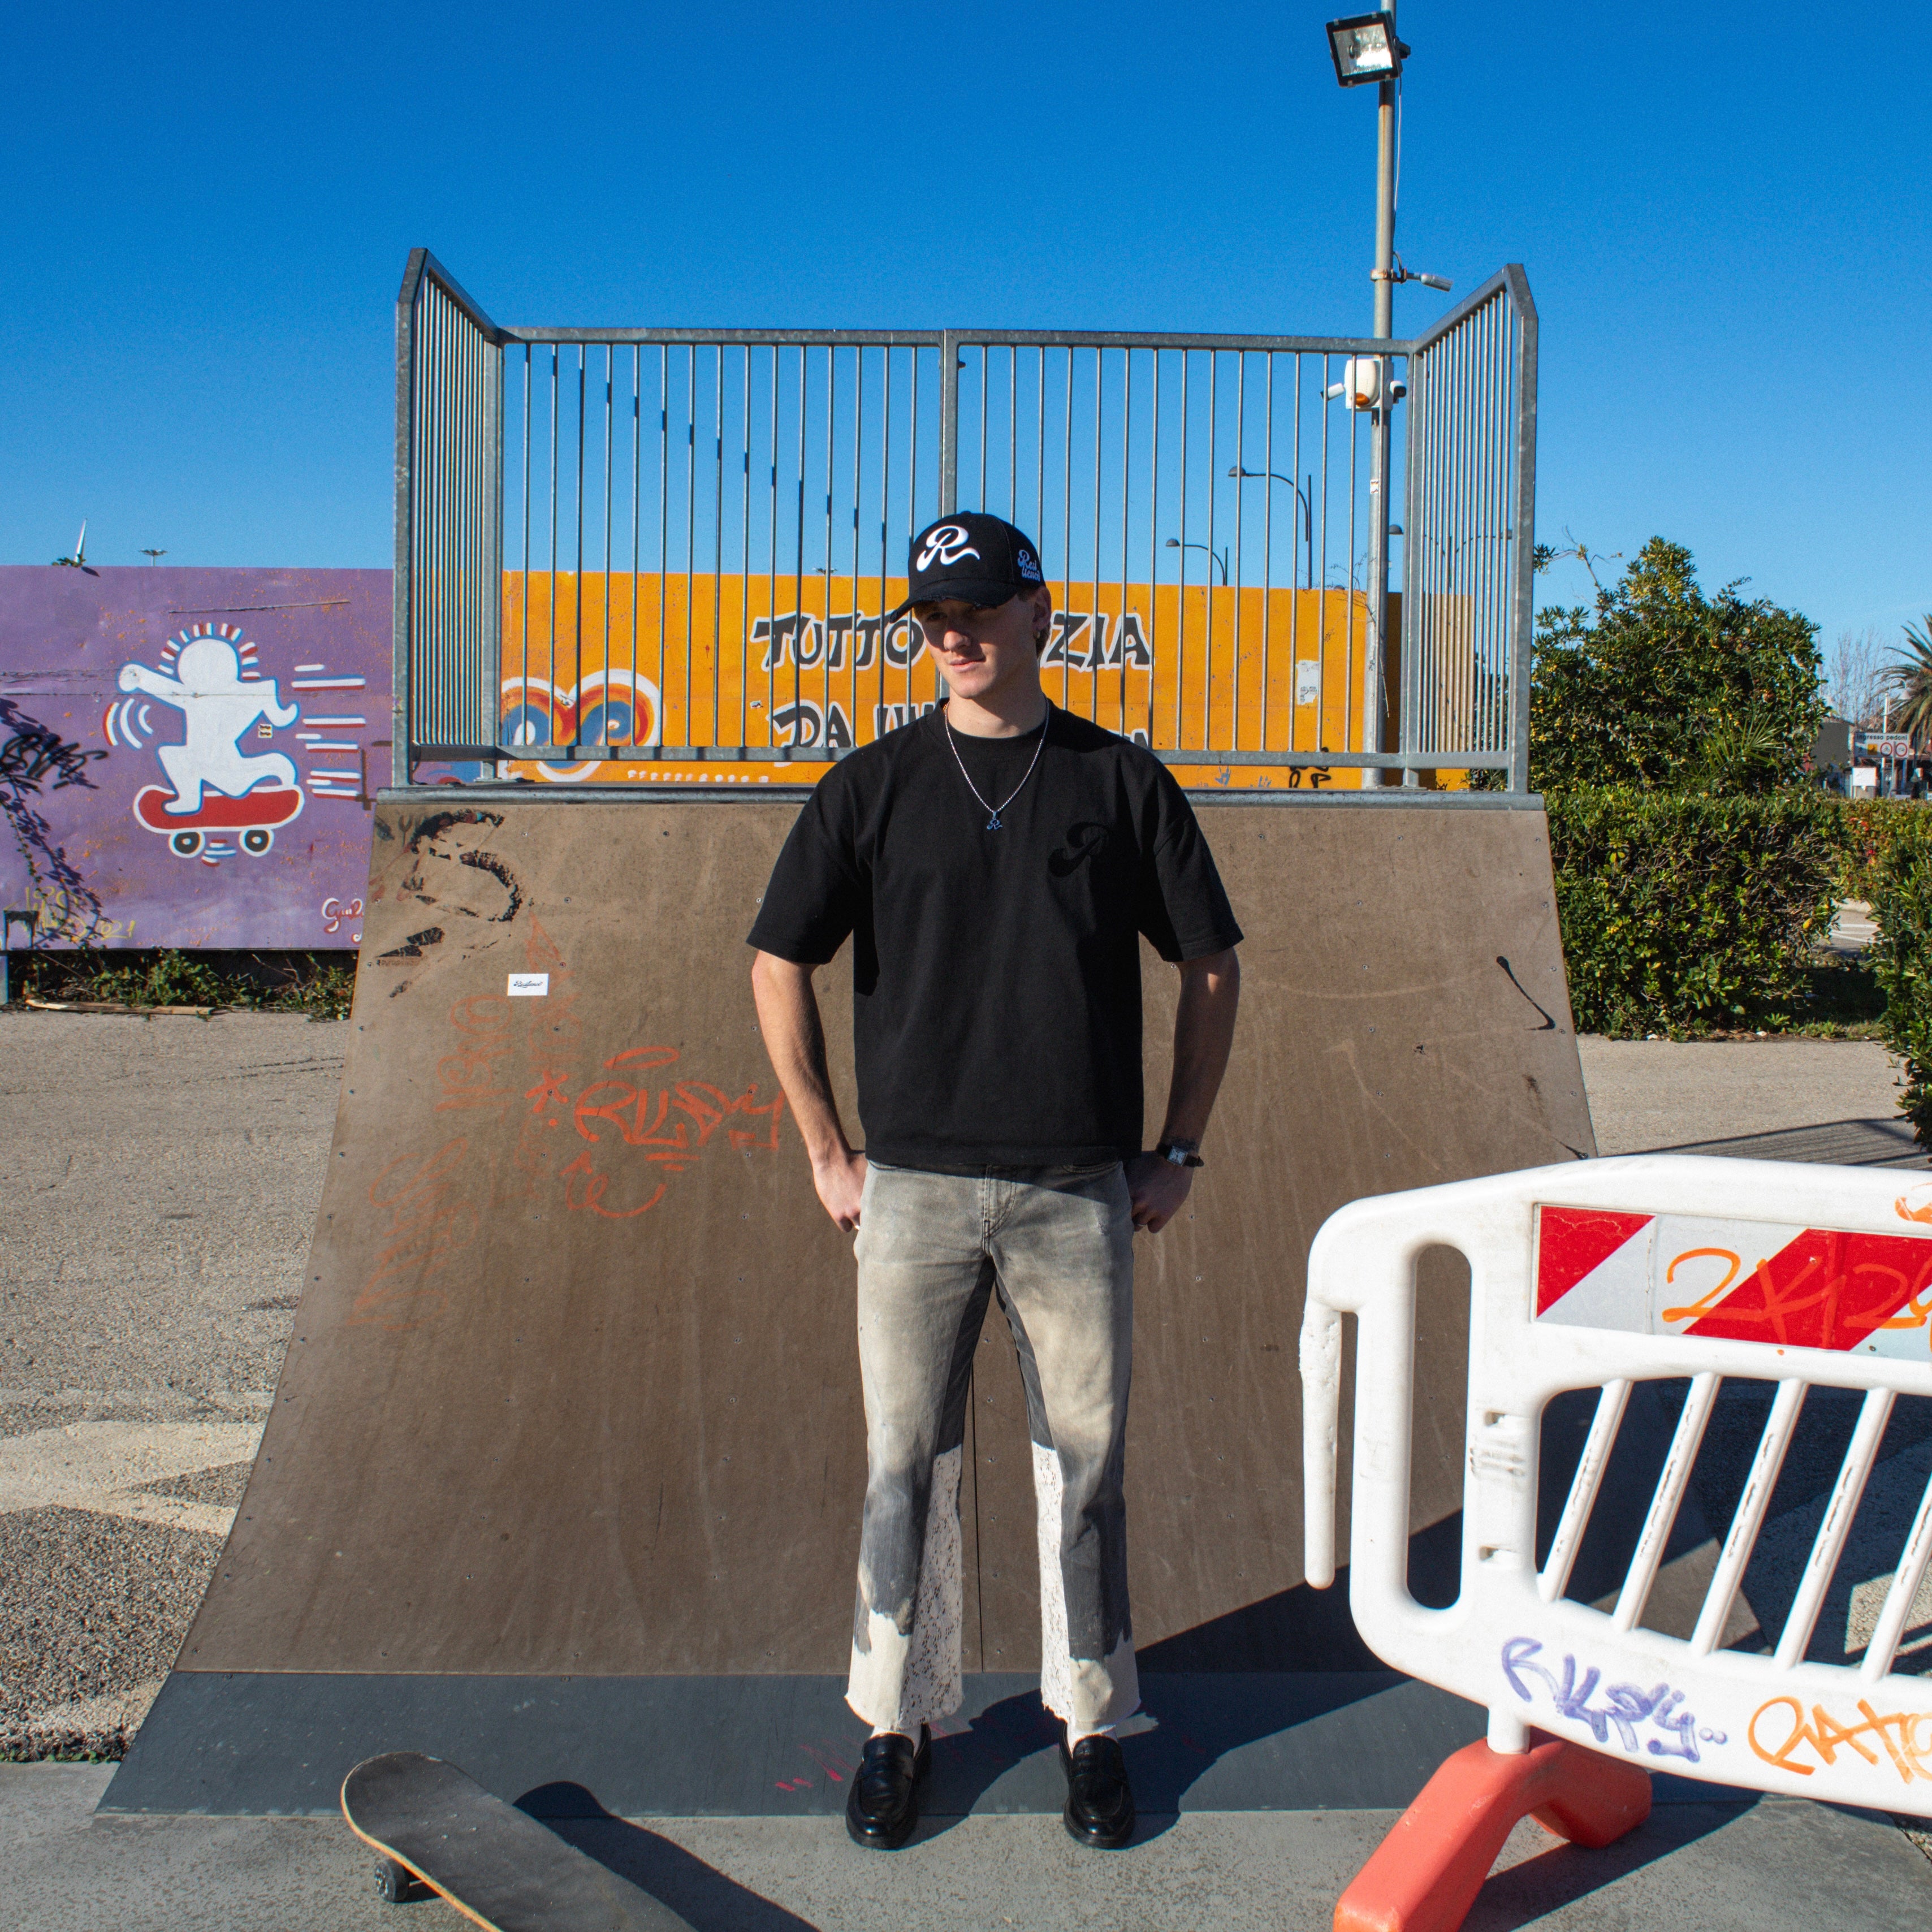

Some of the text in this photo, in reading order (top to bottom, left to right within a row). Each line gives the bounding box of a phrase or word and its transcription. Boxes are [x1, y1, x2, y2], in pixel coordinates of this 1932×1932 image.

[917, 525, 980, 572] R
[750, 610, 1155, 672] TUTTO ZIA
